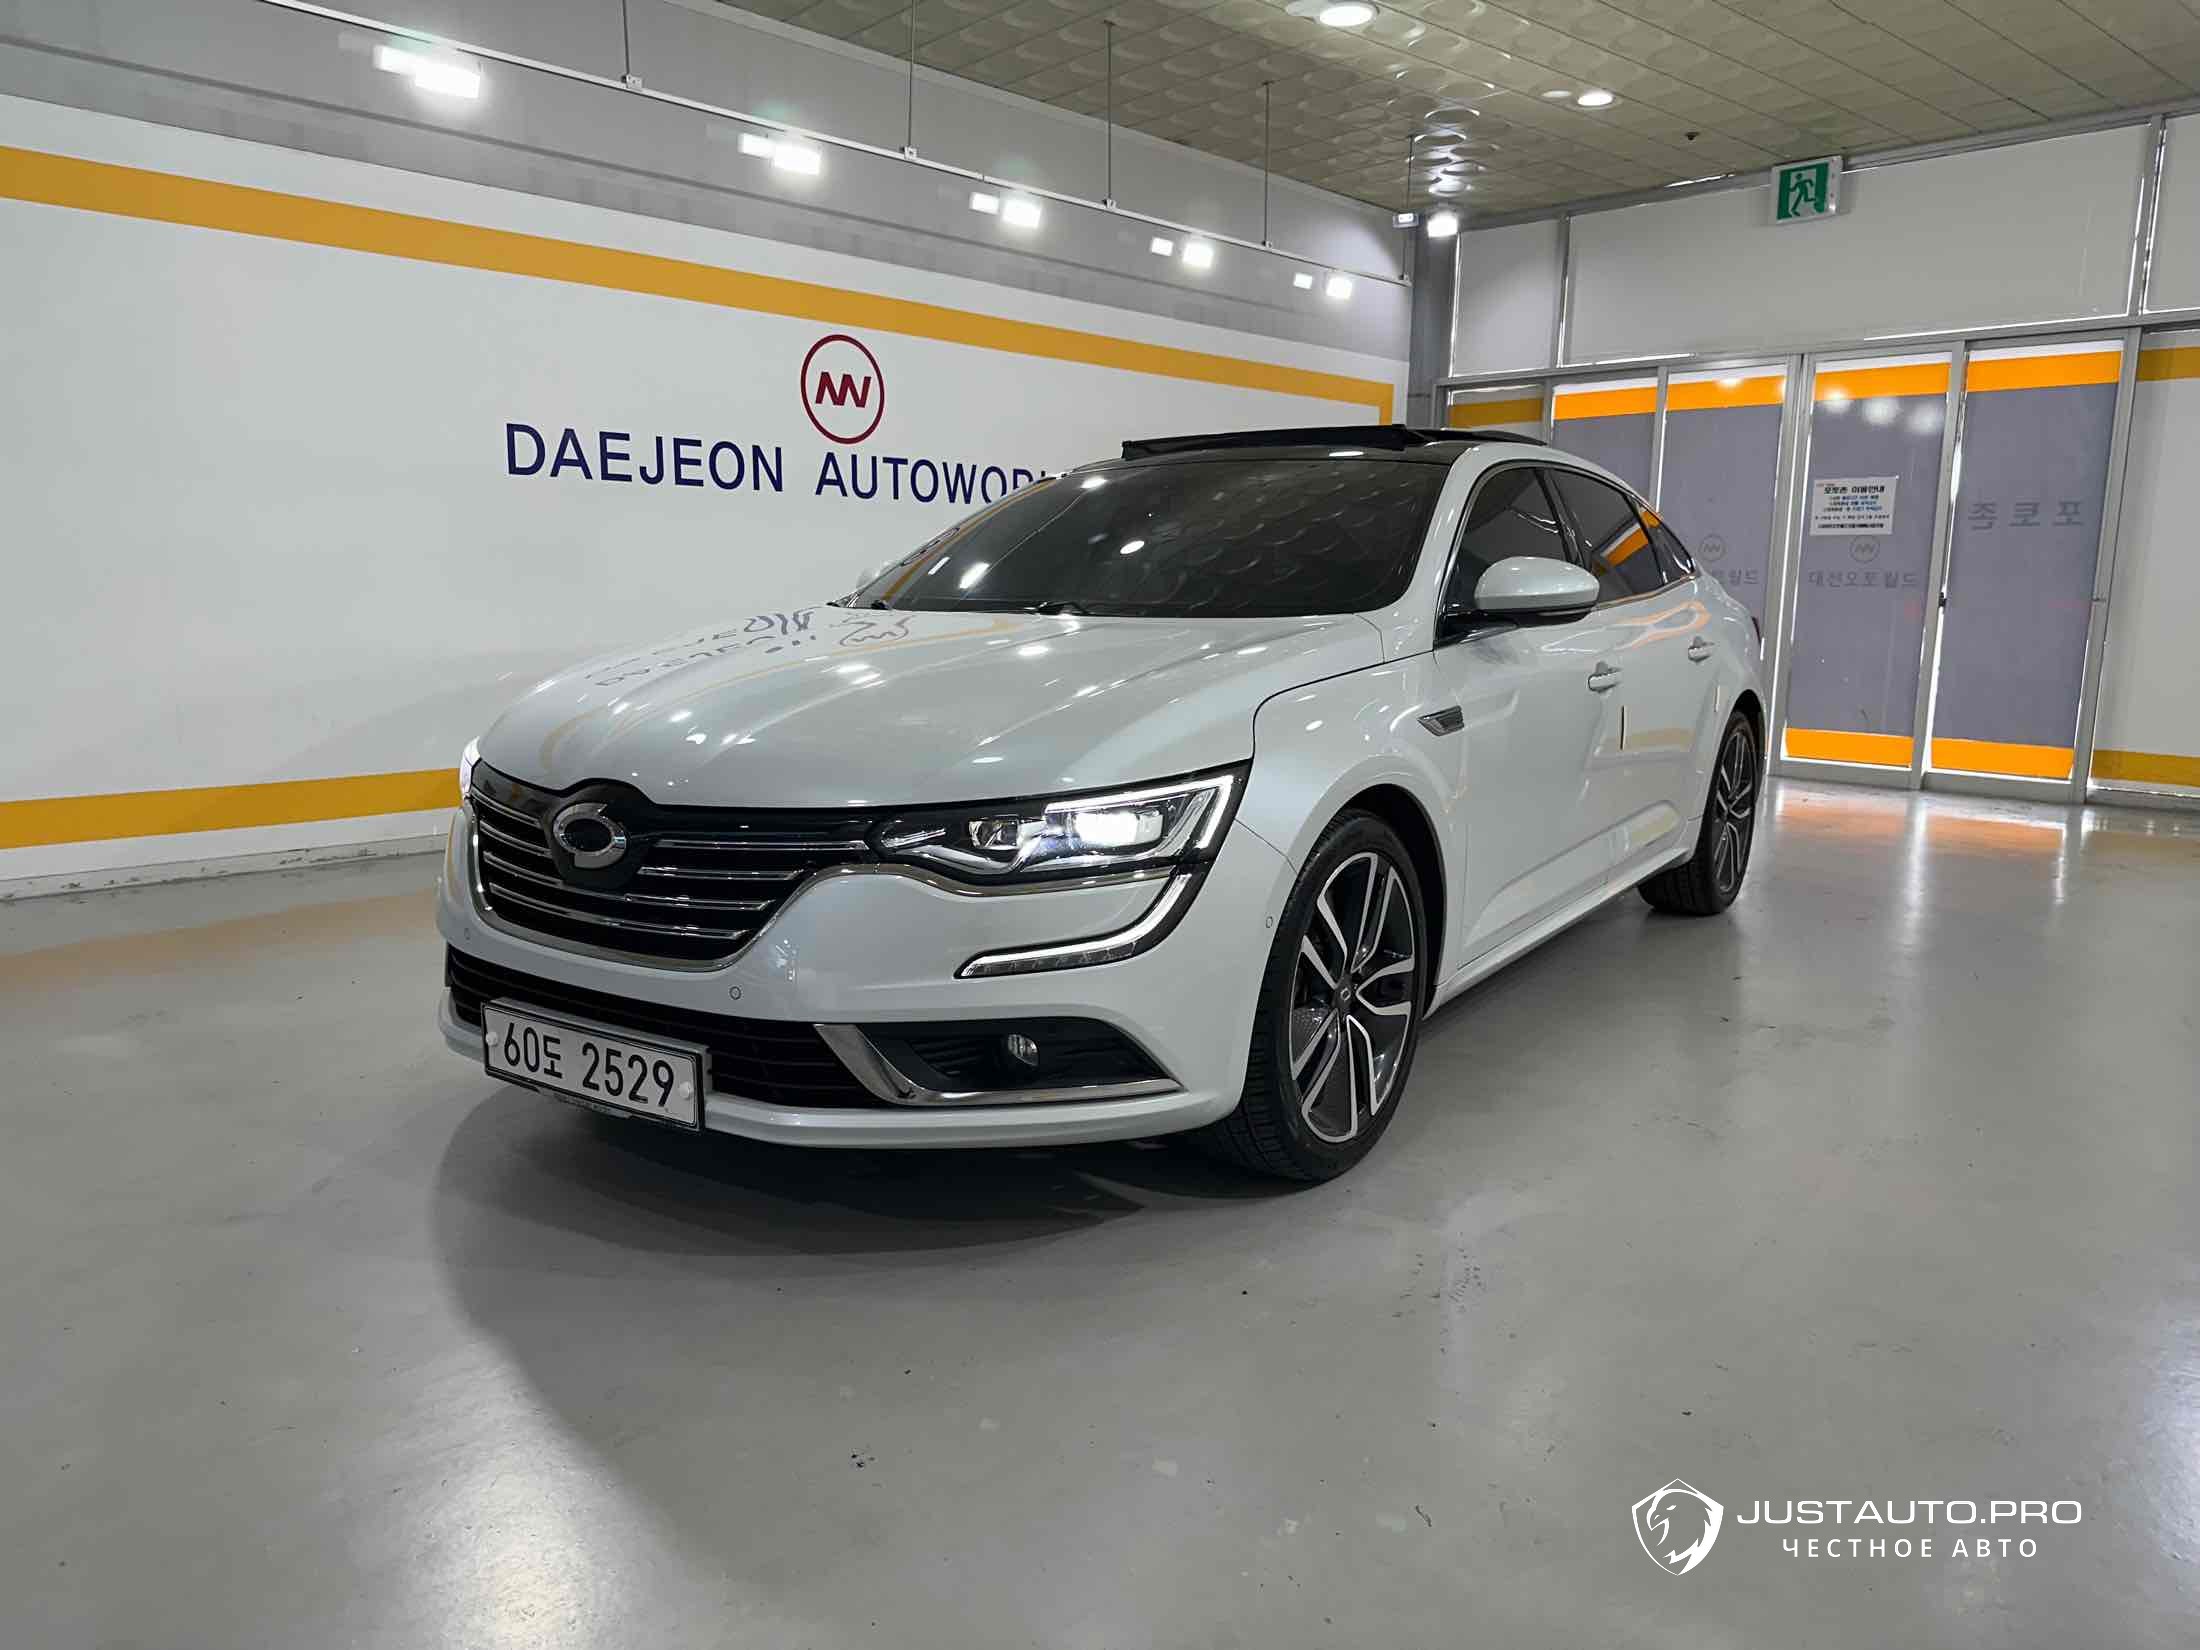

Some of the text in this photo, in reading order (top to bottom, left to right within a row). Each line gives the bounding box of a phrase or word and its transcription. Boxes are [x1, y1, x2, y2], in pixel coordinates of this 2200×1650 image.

[506, 423, 1047, 505] DAEJEON AUTOWO
[504, 1022, 674, 1107] 60도 2529
